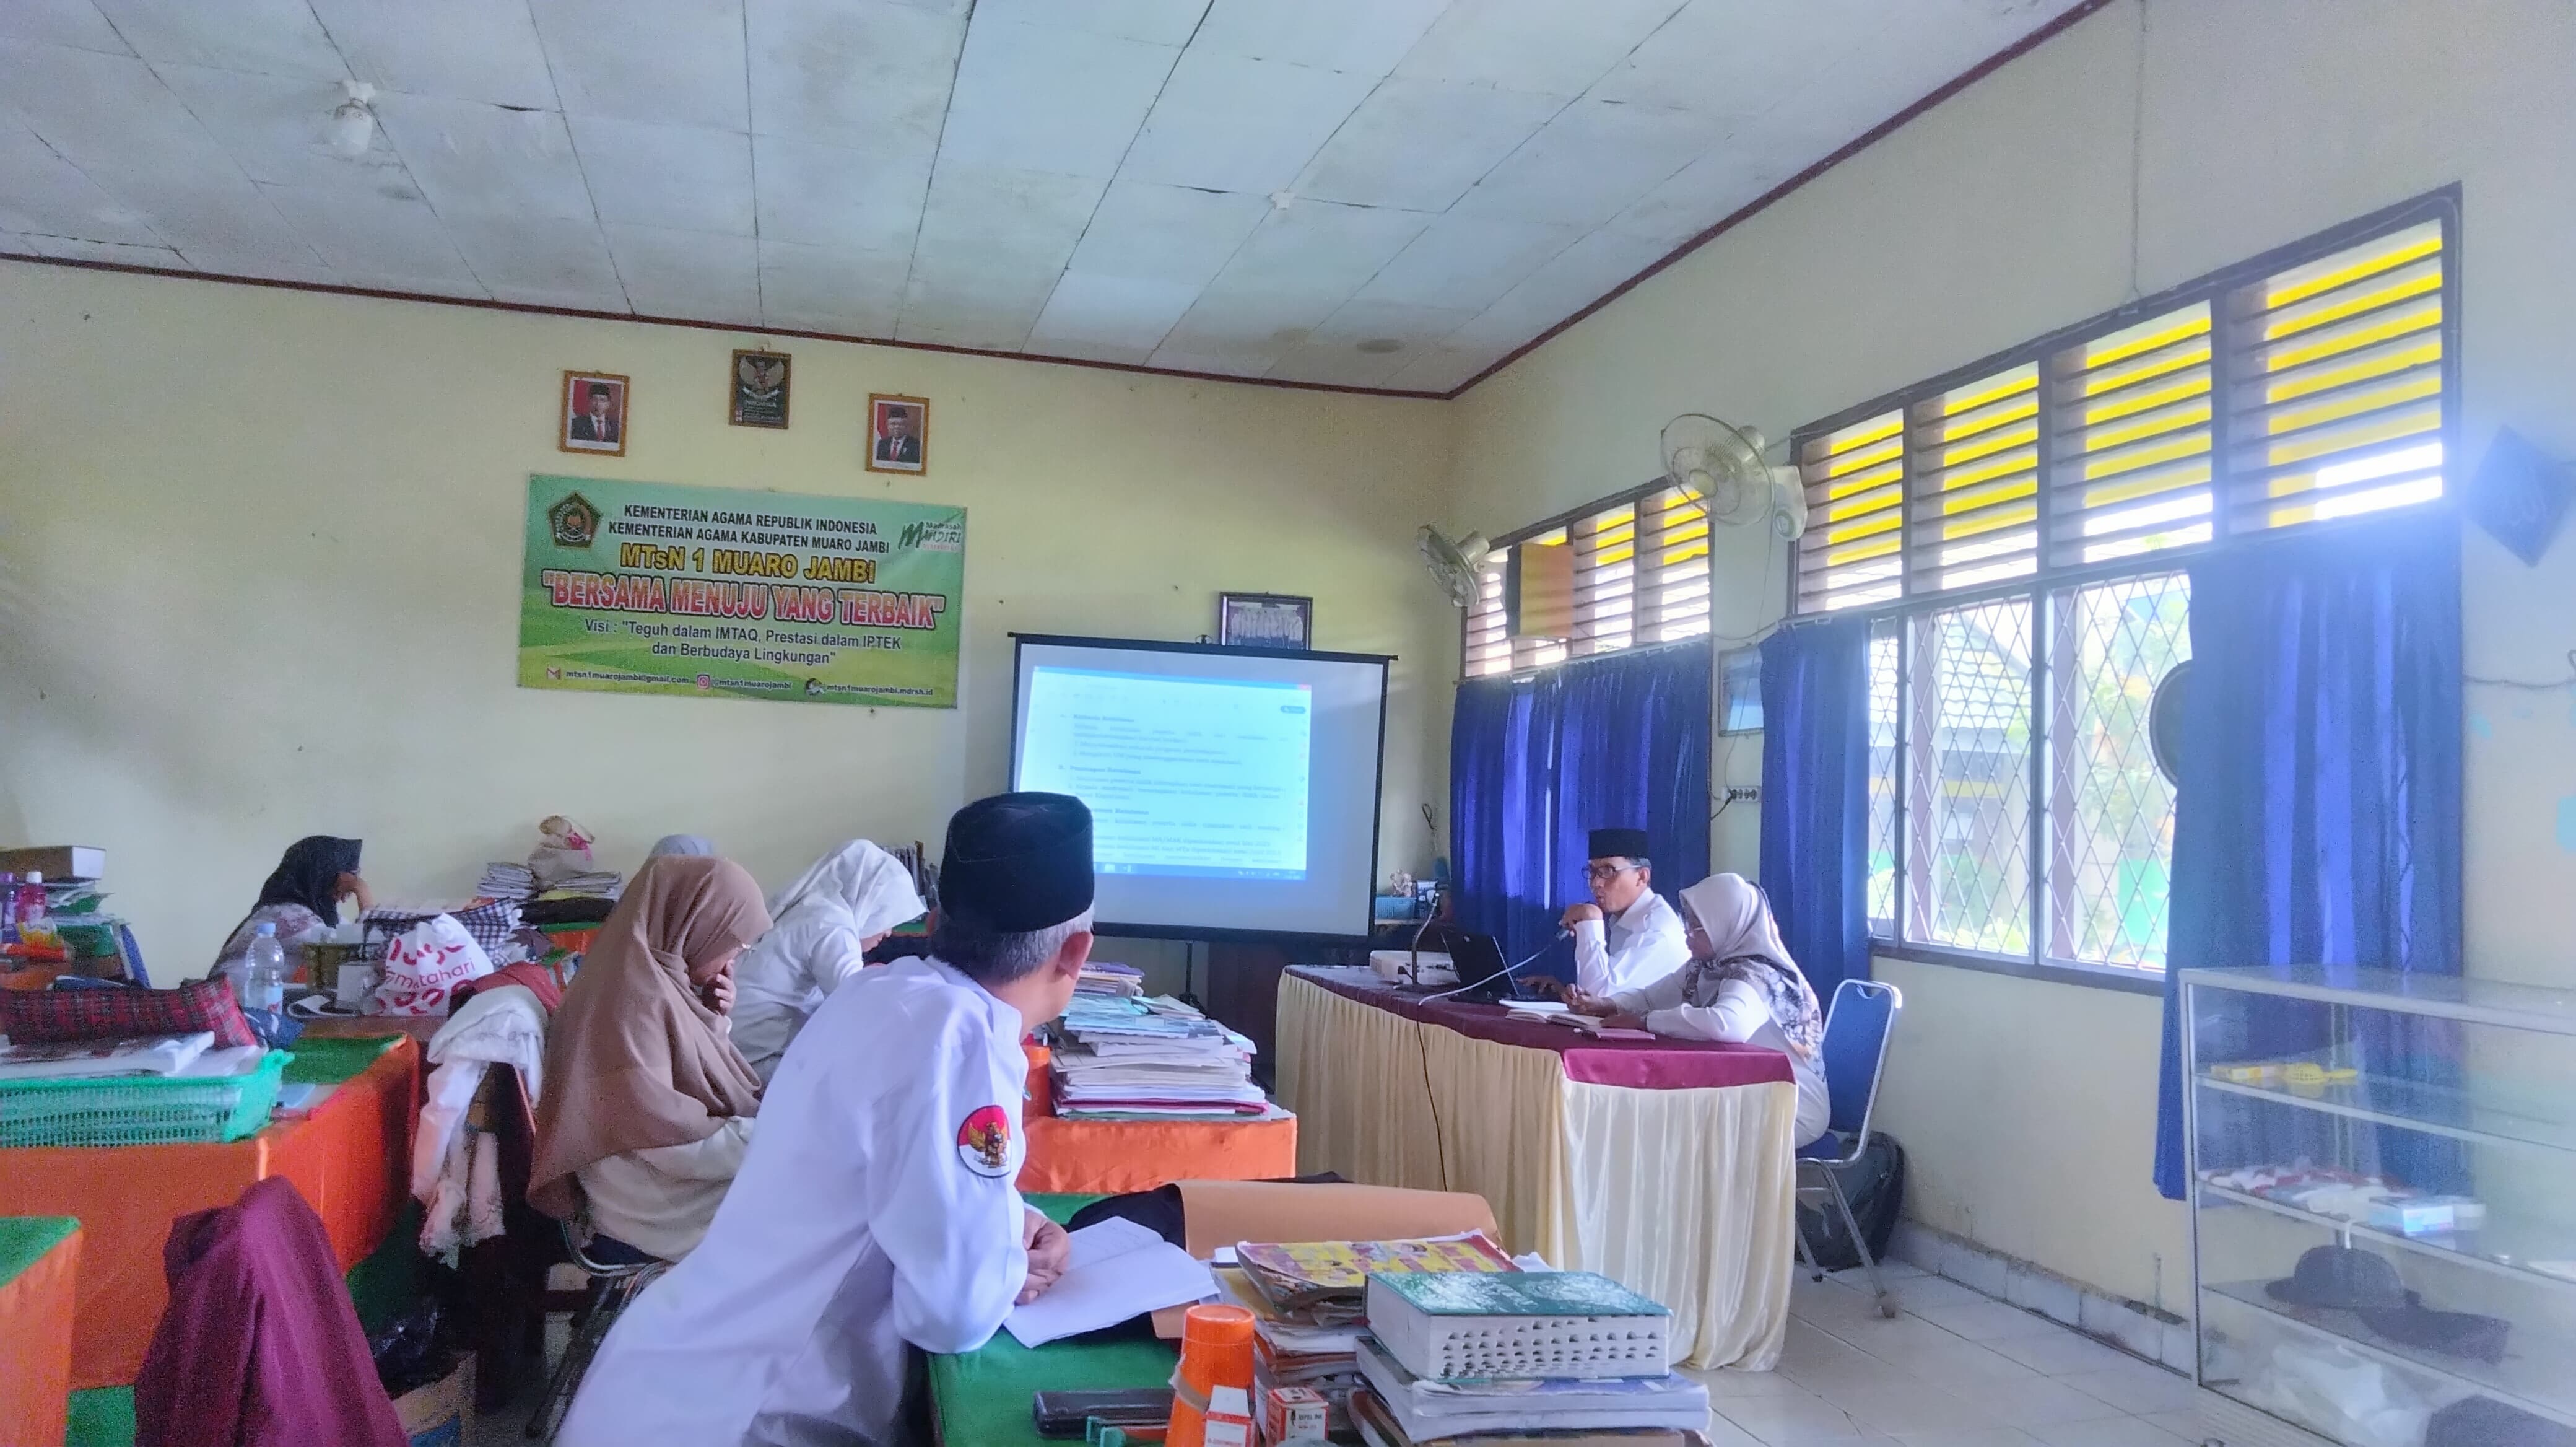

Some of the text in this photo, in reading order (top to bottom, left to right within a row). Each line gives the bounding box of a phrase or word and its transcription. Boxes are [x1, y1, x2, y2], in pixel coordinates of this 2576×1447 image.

[624, 505, 877, 535] KEMENTERIAN AGAMA REPUBLIK INDONESIA
[926, 522, 962, 530] Madrasah
[609, 521, 889, 553] KEMENTERIAN AGAMA KABUPATEN MUARO JAMBI
[620, 542, 876, 583] MTsN 1 MUARO JAMBI
[541, 569, 946, 630] "BERSAMA MENUJU YANG TERBAIK"
[585, 618, 609, 632] Visi
[622, 621, 668, 638] "Teguh
[672, 624, 711, 639] dalam
[716, 626, 762, 642] IMTAQ,
[766, 629, 817, 645] Prestasi
[821, 633, 859, 647] dalam
[863, 636, 902, 650] IPTEK
[652, 642, 836, 666] dan Berbudaya Lingkungan"
